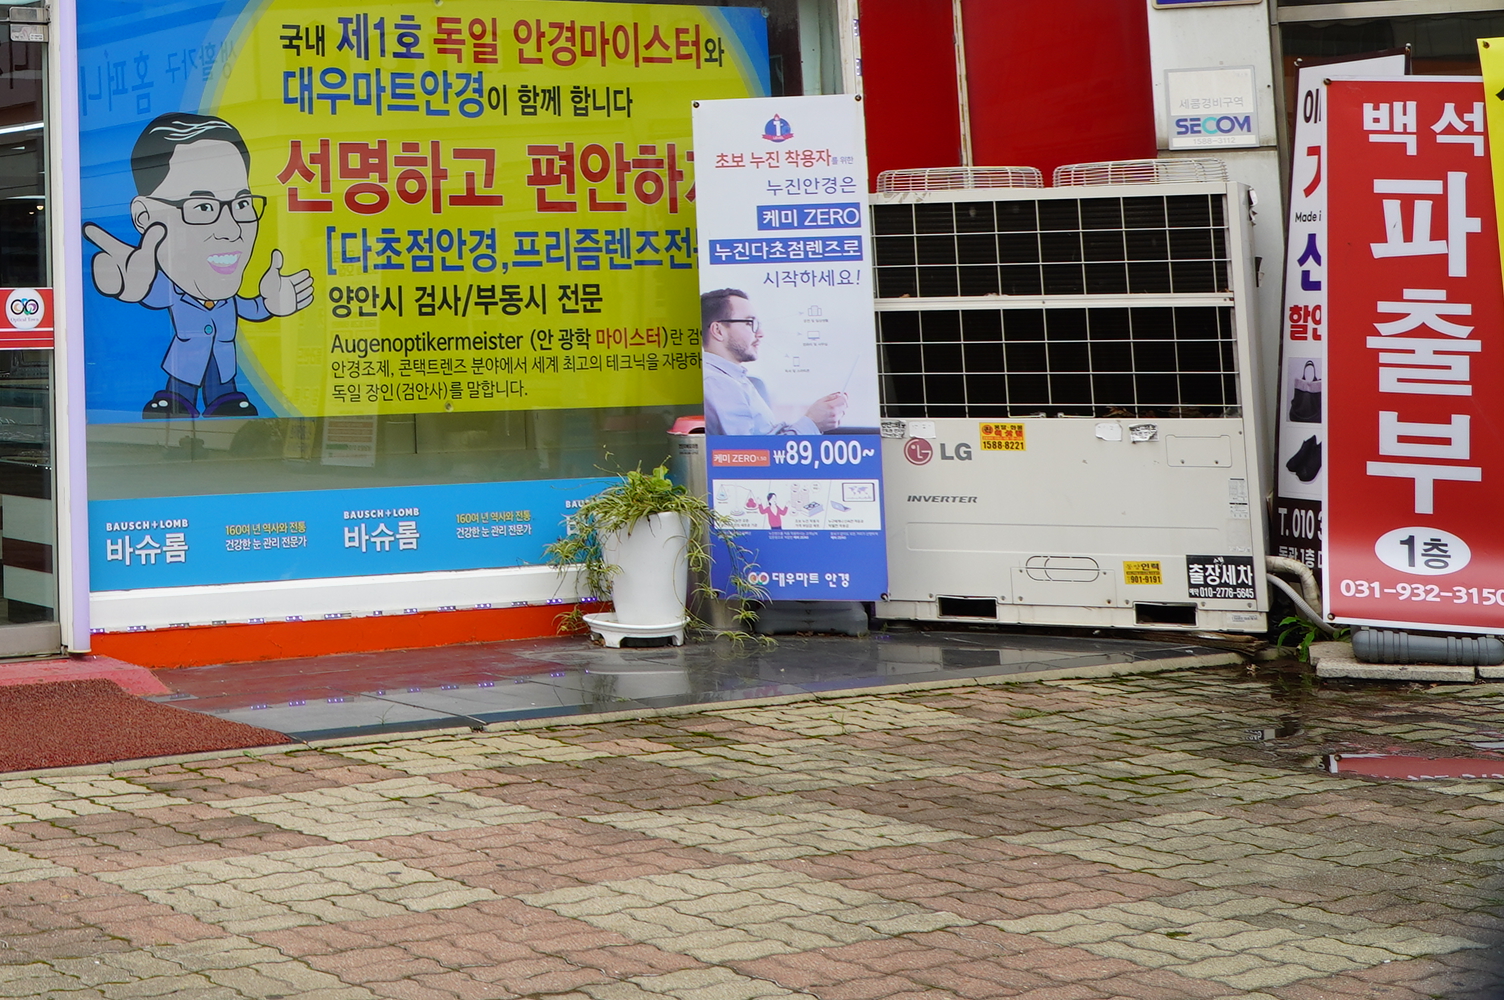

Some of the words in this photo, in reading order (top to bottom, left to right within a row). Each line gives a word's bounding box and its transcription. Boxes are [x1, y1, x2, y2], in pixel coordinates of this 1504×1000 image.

[279, 24, 326, 57] 국내
[336, 12, 424, 61] 제1호
[433, 16, 498, 64] 독일
[513, 18, 724, 69] 안경마이스터와
[282, 67, 507, 118] 대우마트안경이
[517, 85, 561, 117] 함께
[570, 85, 633, 118] 합니다
[1175, 116, 1251, 135] SECOM
[1193, 137, 1236, 145] 1588-3112
[715, 152, 746, 168] 초보
[749, 151, 780, 169] 누진
[276, 137, 503, 215] 선명하고
[766, 176, 857, 196] 누진안경은
[762, 209, 798, 227] 케미
[804, 208, 860, 226] ZERO
[1295, 211, 1316, 223] Made
[715, 239, 861, 261] 누진다초점렌즈로
[763, 269, 861, 288] 시작하세요!
[329, 285, 403, 318] 양안시
[414, 283, 547, 318] 검사/부동시
[558, 283, 603, 314] 전문
[331, 330, 523, 360] Augenoptikermeister
[558, 327, 591, 351] 광학
[1366, 171, 1482, 514] 파출부
[331, 361, 394, 379] 안경조제,
[398, 359, 467, 377] 콘택트렌즈
[471, 356, 527, 375] 분야에서
[532, 355, 560, 374] 세계
[563, 354, 603, 372] 최고의
[606, 353, 659, 371] 테크닉을
[331, 383, 361, 402] 독일
[467, 379, 528, 399] 말합니다.
[713, 454, 731, 464] 케미
[940, 443, 973, 461] LG
[907, 495, 978, 503] INVERTER
[344, 508, 420, 520] BAUSCH+LOMB
[106, 519, 189, 532] BAUSCH+LOMB
[252, 523, 261, 535] 년
[262, 522, 287, 534] 역사와
[289, 521, 306, 533] 전통
[456, 526, 480, 538] 건강한
[481, 526, 489, 537] 눈
[491, 525, 506, 536] 관리
[508, 524, 532, 536] 전문가
[1292, 508, 1315, 540] 010
[225, 538, 251, 551] 건강한
[253, 538, 261, 550] 눈
[263, 536, 280, 549] 관리
[282, 535, 307, 548] 전문가
[344, 520, 420, 552] 바슈롬
[106, 532, 189, 566] 바슈롬
[1399, 535, 1451, 569] 1층
[772, 572, 820, 587] 대우마트
[825, 571, 850, 588] 안경
[1189, 563, 1253, 586] 출장세차
